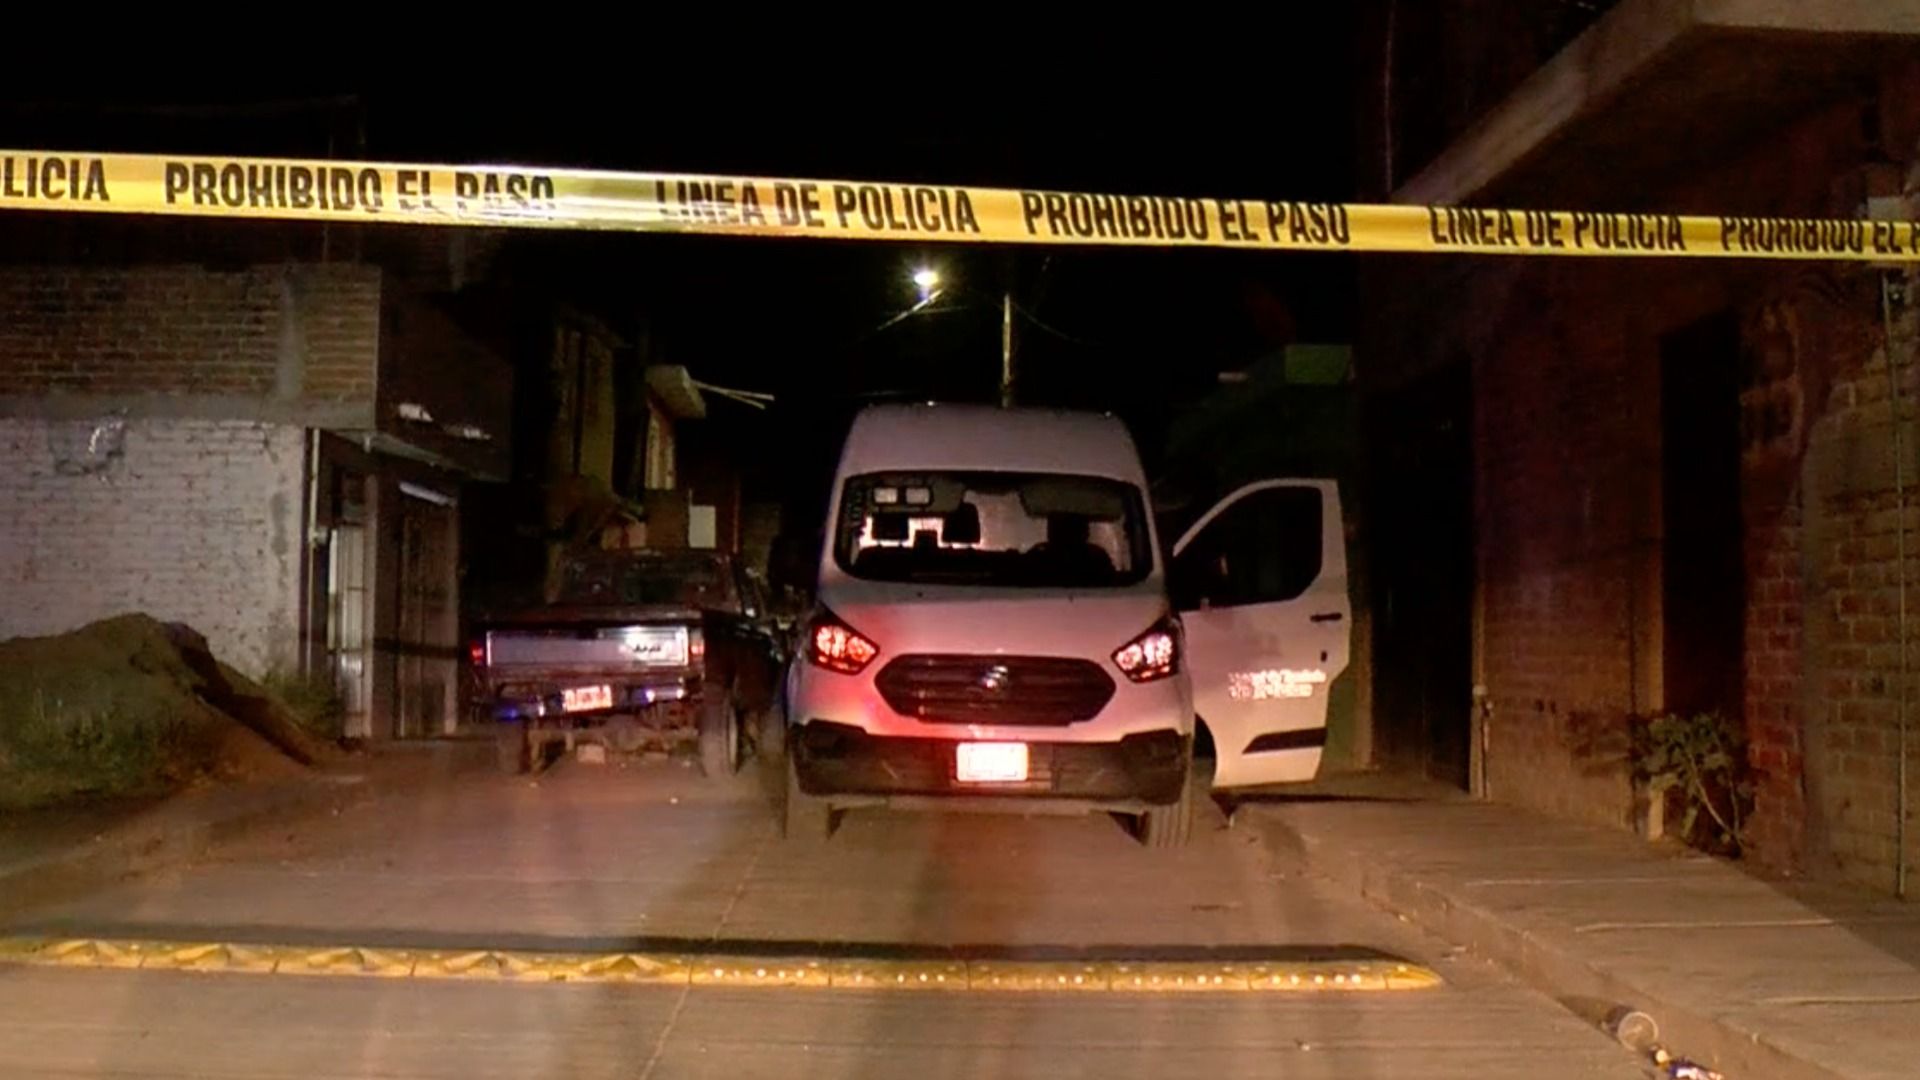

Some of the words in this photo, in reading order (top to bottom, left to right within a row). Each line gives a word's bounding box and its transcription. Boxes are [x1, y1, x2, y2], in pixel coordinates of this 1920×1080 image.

[0, 157, 110, 201] LICIA
[165, 162, 384, 212] PROHIBIDO
[397, 170, 434, 210] EL
[455, 172, 556, 219] PASO
[656, 180, 767, 225] LINEA
[774, 182, 826, 227] DE
[833, 184, 981, 233] POLICIA
[1021, 192, 1209, 240] PROHIBIDO
[1217, 200, 1260, 241] EL
[1266, 201, 1350, 244] PASO
[1428, 205, 1520, 246] LINEA
[1525, 210, 1564, 247] DE
[1572, 211, 1687, 251] POLICIA
[1720, 216, 1864, 253] PROHIBIDO
[1872, 221, 1904, 254] EL
